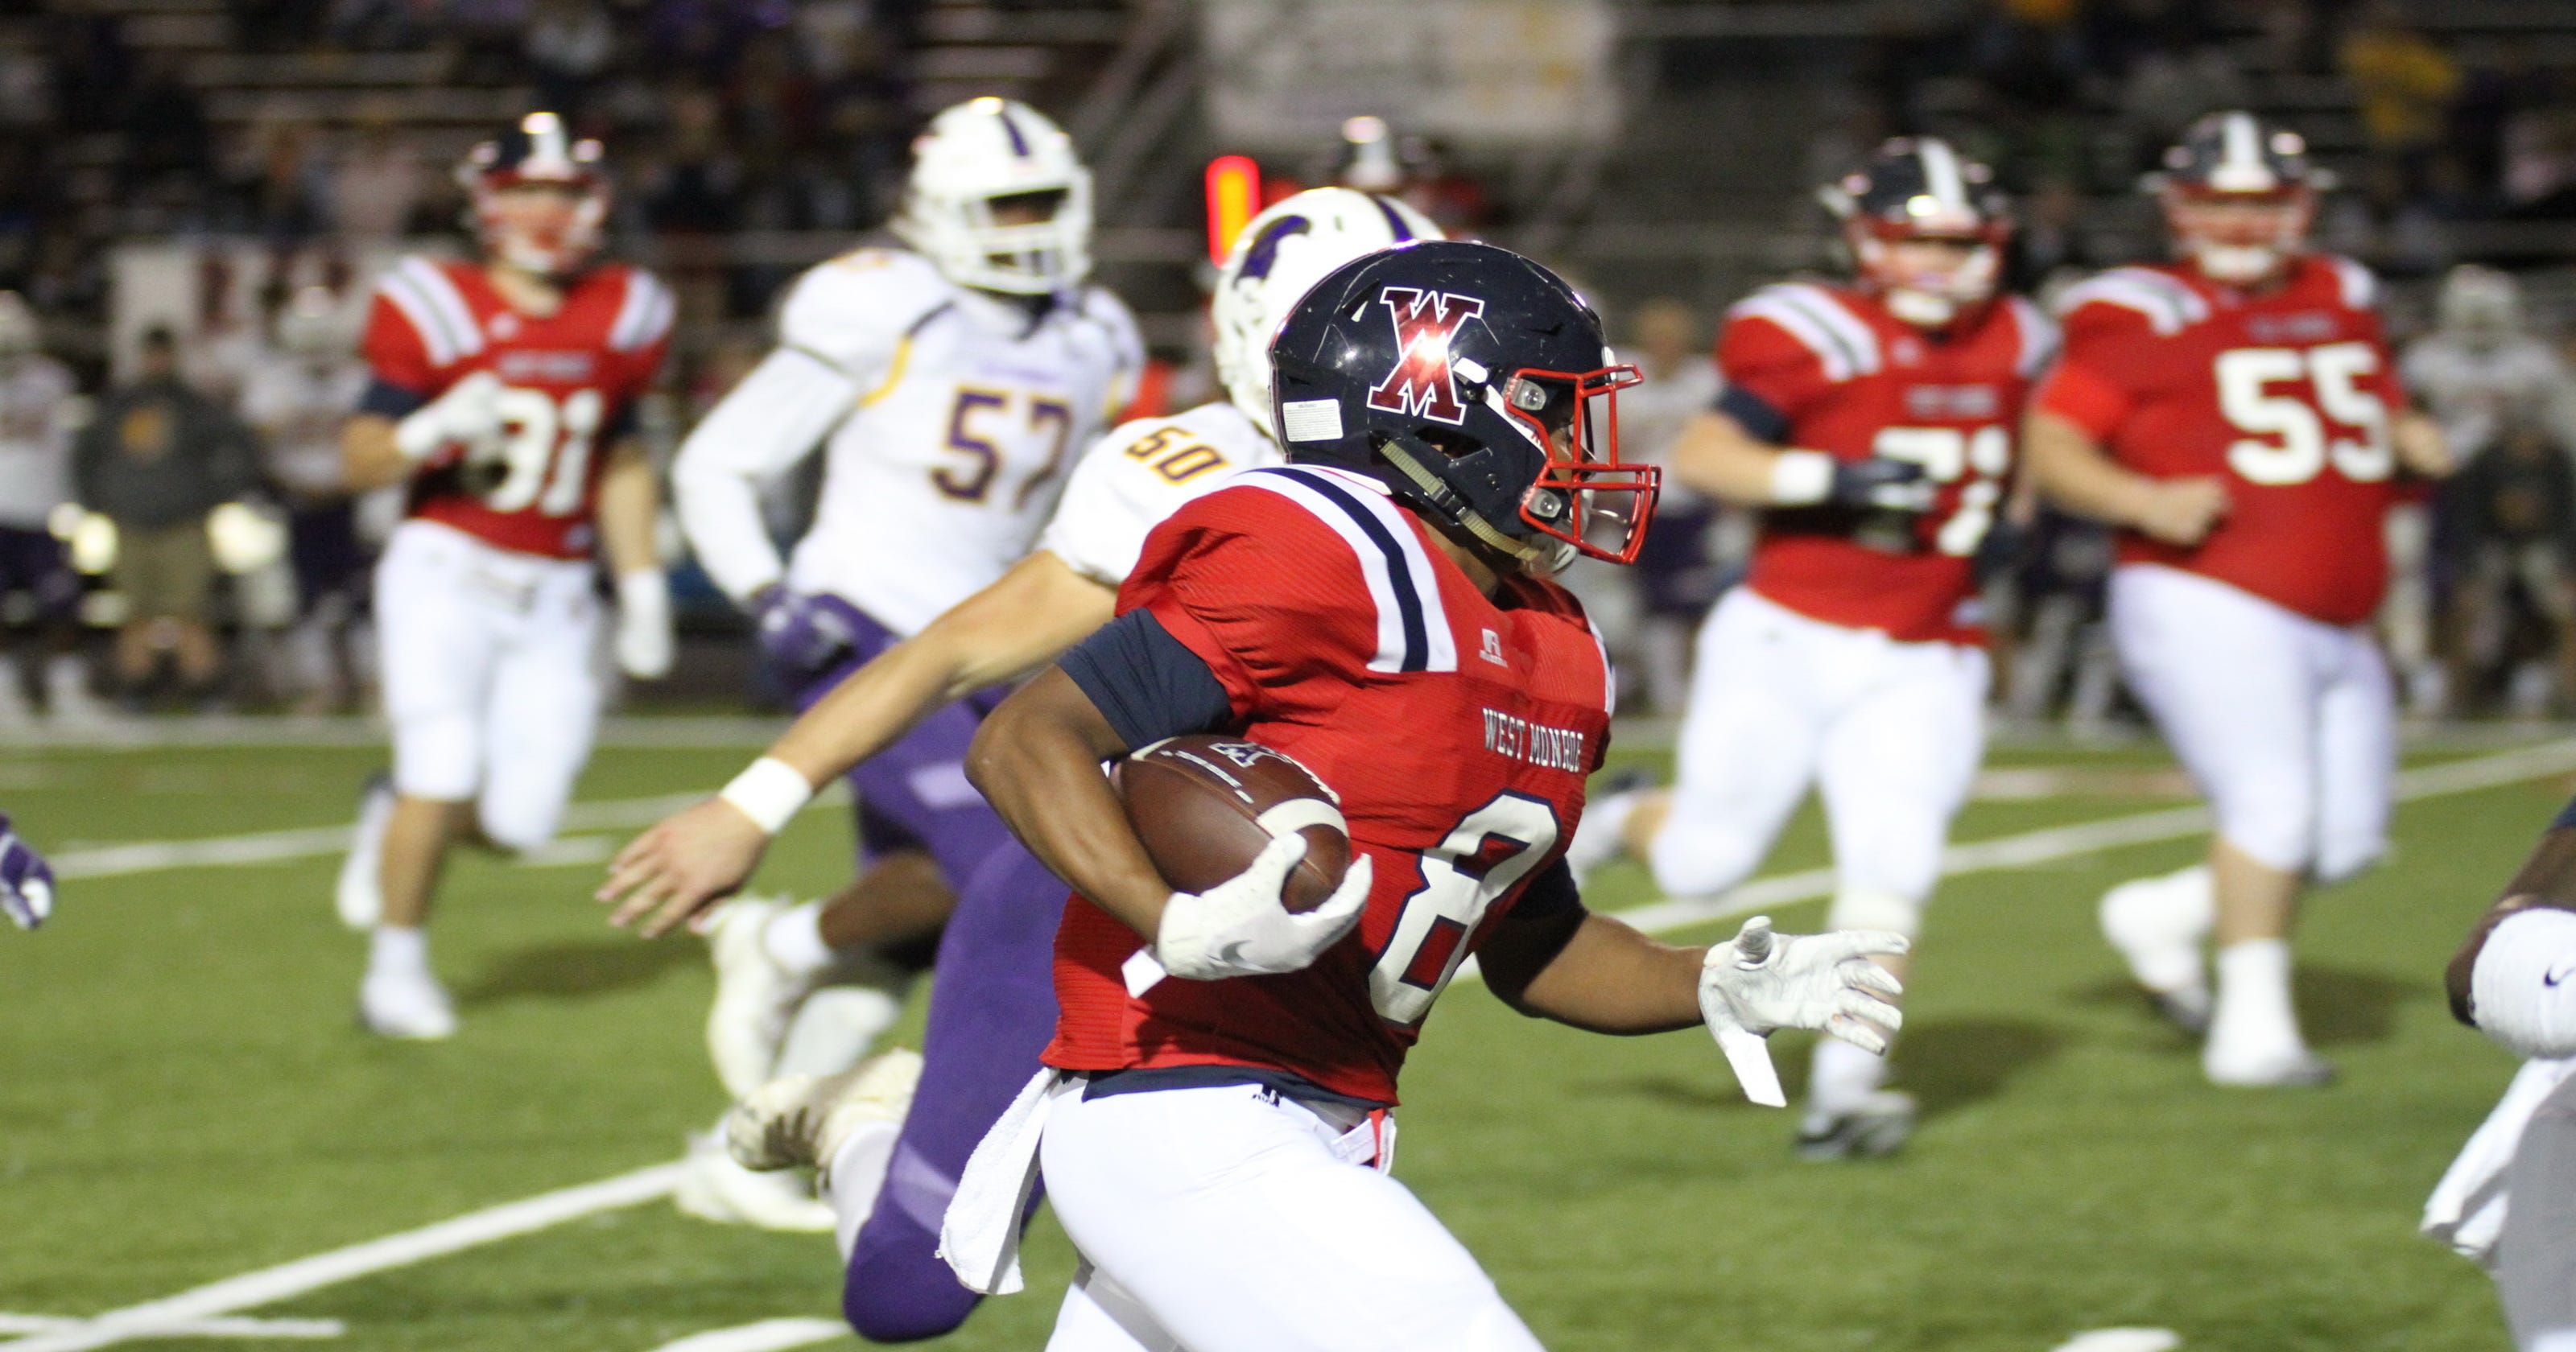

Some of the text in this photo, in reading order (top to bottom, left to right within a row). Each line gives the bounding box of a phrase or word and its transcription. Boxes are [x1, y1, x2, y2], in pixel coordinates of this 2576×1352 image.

[927, 385, 1072, 513] 57
[1124, 424, 1232, 485] 50
[2215, 340, 2393, 486] 55
[1483, 707, 1583, 773] WEST MONROE
[1368, 787, 1562, 1031] 8
